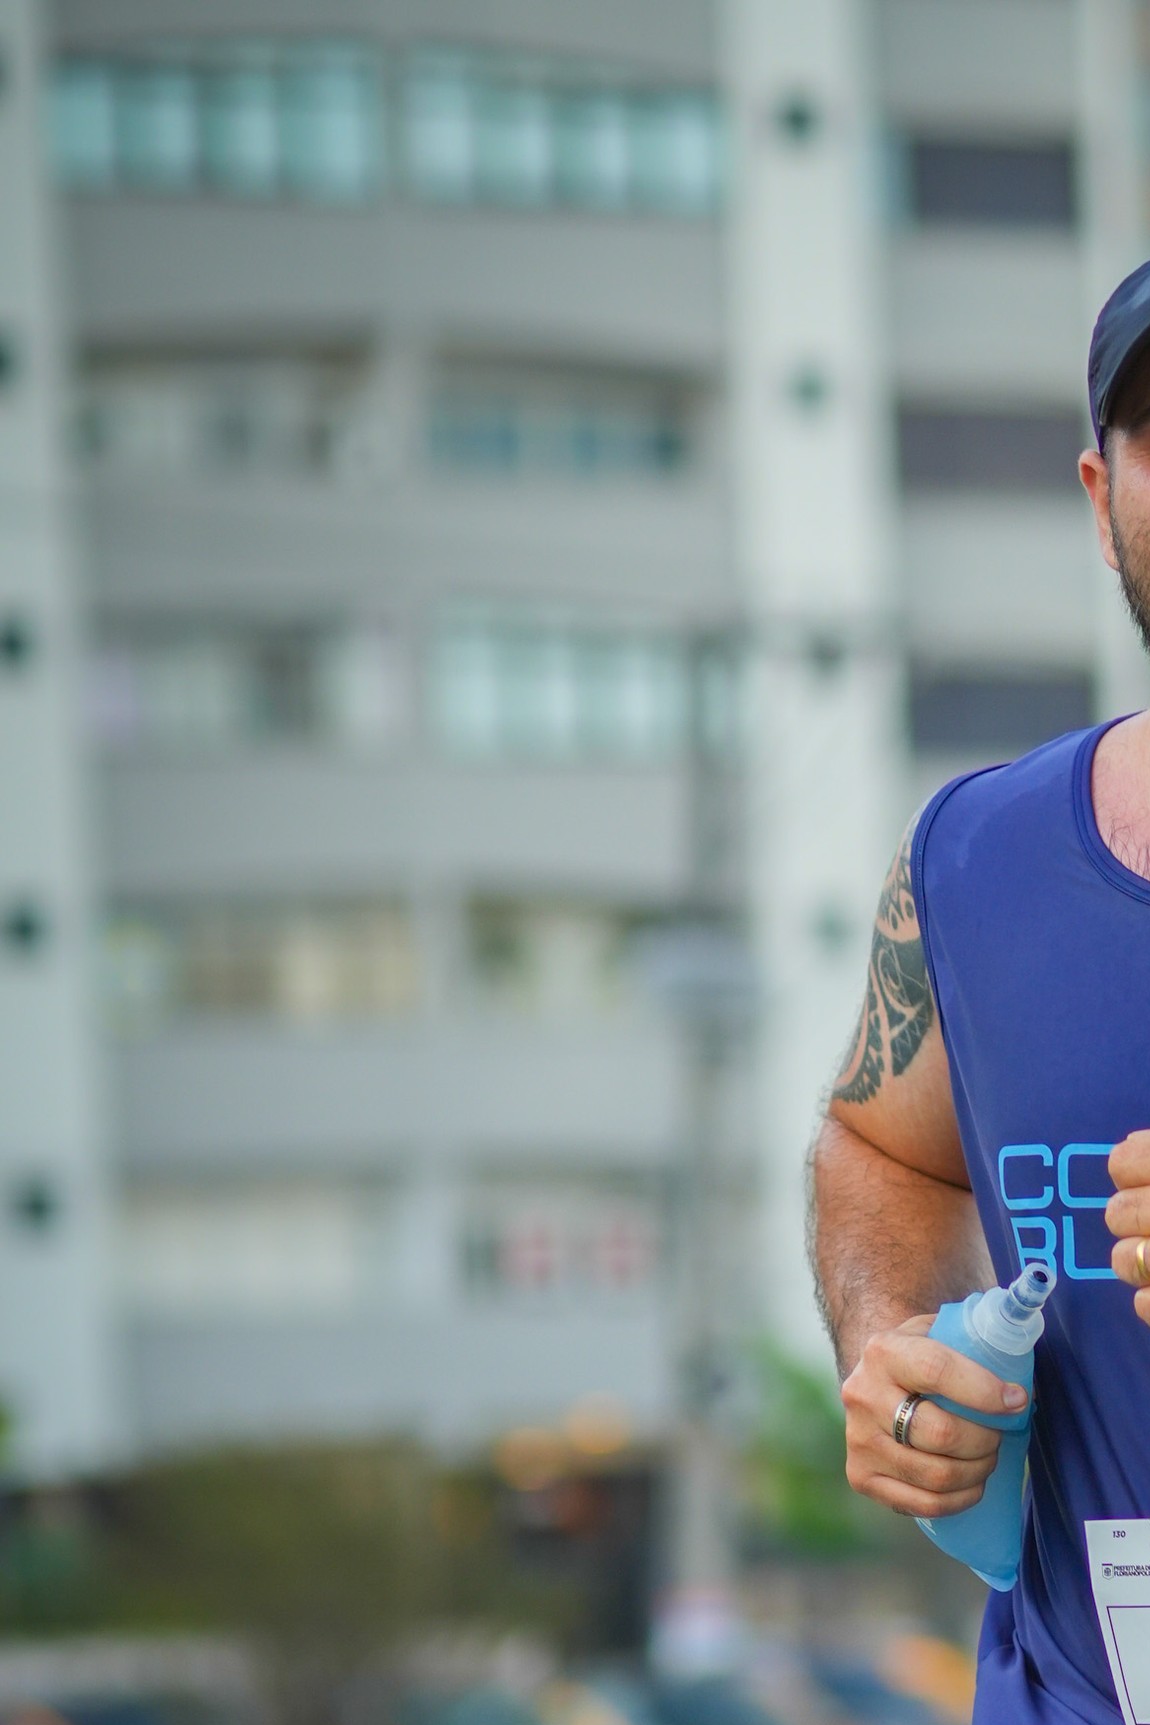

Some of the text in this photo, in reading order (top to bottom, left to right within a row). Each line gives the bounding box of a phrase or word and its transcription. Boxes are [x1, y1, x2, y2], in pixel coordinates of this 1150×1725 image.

[999, 1143, 1114, 1210] CO
[1010, 1216, 1119, 1280] BL
[1112, 1530, 1126, 1538] 130
